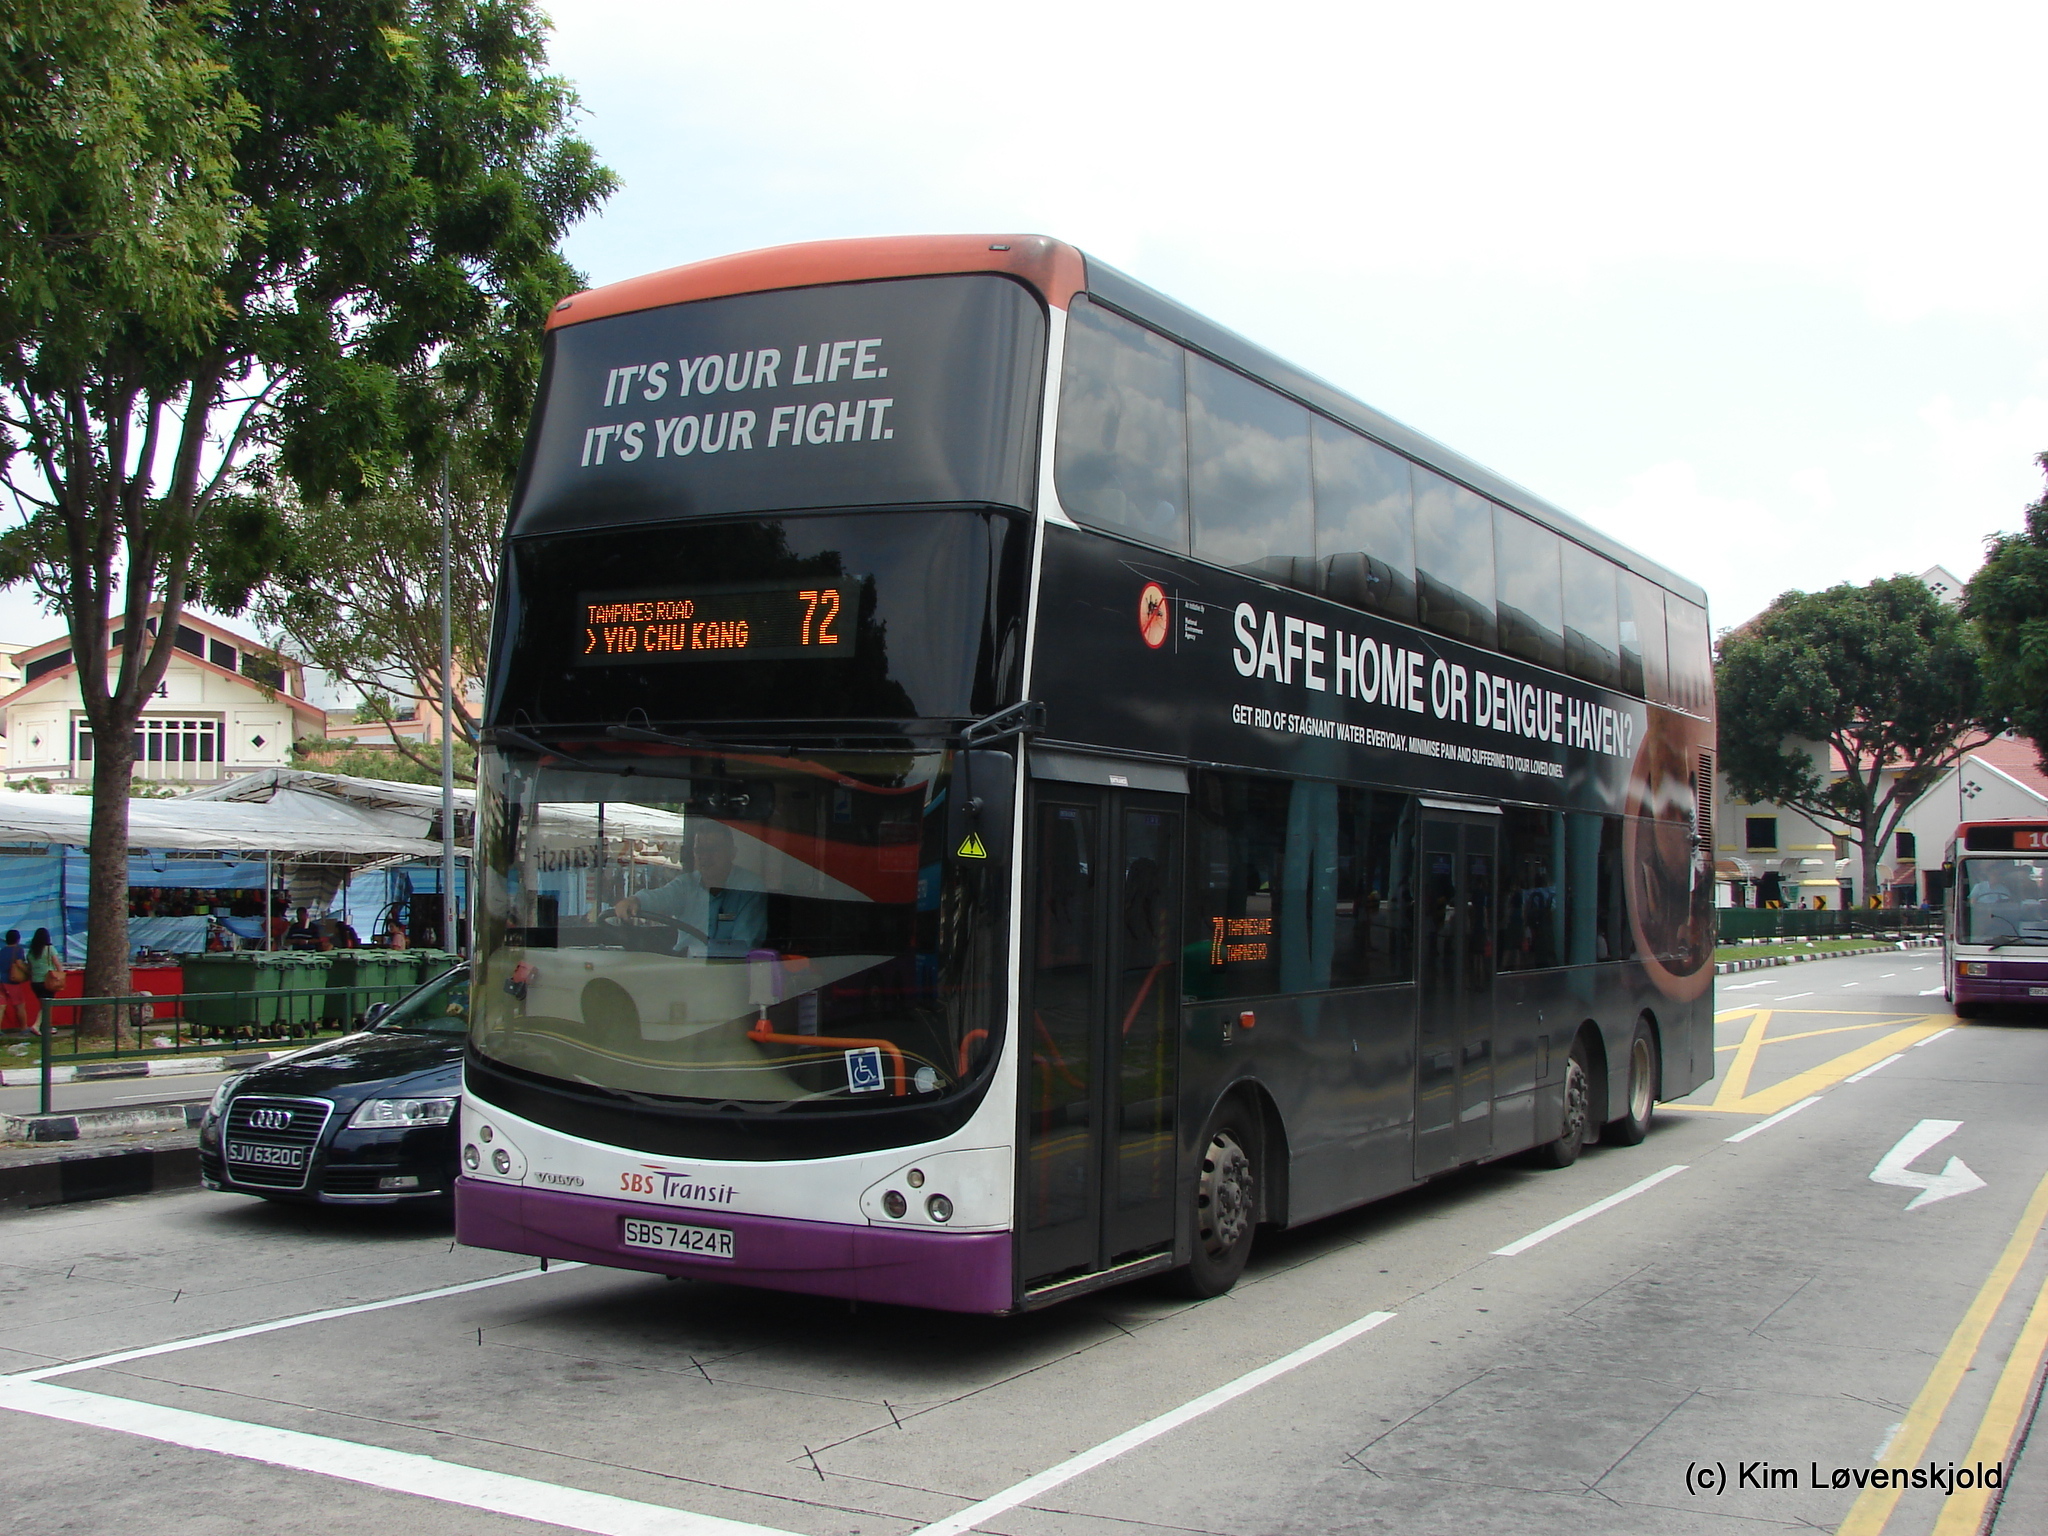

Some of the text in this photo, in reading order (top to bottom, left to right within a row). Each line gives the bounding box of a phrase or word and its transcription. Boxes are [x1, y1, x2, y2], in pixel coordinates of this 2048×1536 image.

[603, 338, 888, 407] IT'S YOUR LIFE.
[581, 398, 894, 467] IT'S YOUR FIGHT.
[587, 600, 695, 624] TAMPINES ROAD
[799, 589, 840, 646] 72
[604, 620, 749, 653] YIO CHU KANG
[1232, 602, 1634, 759] SAFE HOME OR DENGUE HAVEN?
[1232, 703, 1254, 726] GET
[1254, 707, 1272, 729] RID
[1273, 711, 1287, 731] OF
[1288, 715, 1336, 740] STAGNANT
[1336, 722, 1365, 745] WATER
[1366, 728, 1408, 752] EVERYDAY.
[1408, 736, 1440, 758] MINIMISE
[1441, 742, 1457, 761] PAIN
[1457, 745, 1471, 763] AND
[1471, 748, 1506, 770] SUFFERING
[1505, 755, 1514, 770] TO
[1513, 756, 1530, 773] YOUR
[1530, 758, 1548, 776] LOVED
[1211, 917, 1225, 965] 72
[229, 1144, 302, 1166] SJV6320C
[534, 1171, 585, 1187] VOLVO
[620, 1171, 741, 1204] SBS Transit
[626, 1222, 732, 1254] SBS7424R
